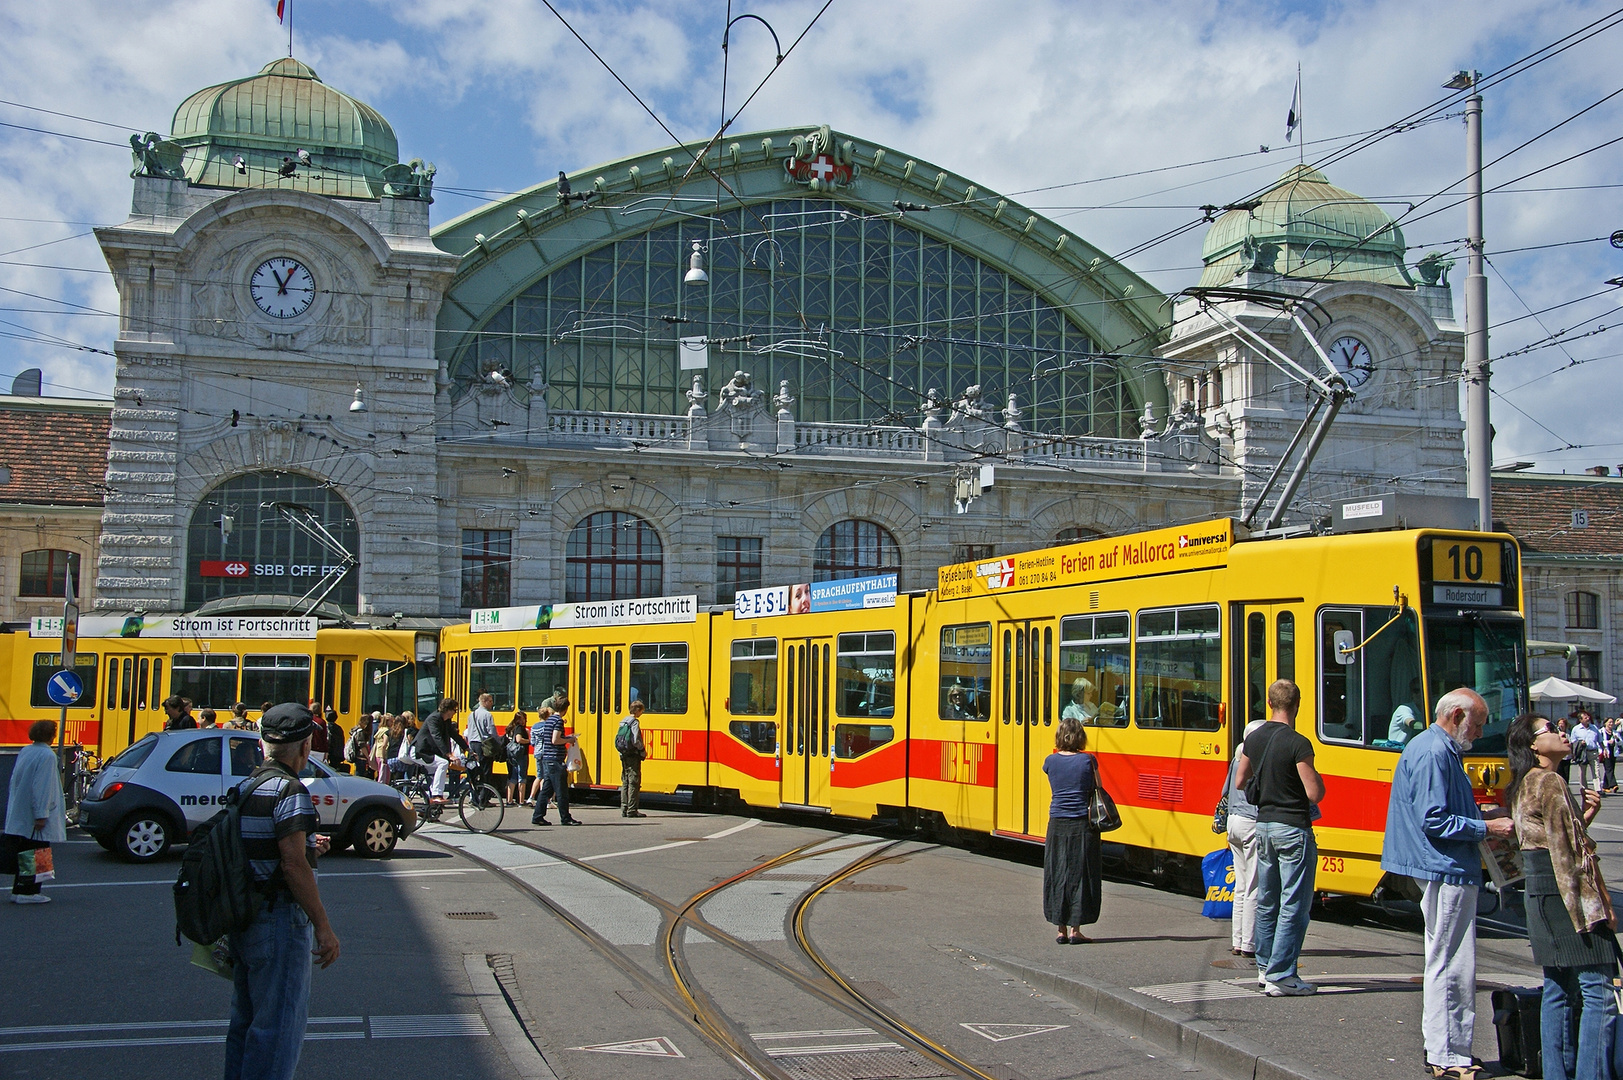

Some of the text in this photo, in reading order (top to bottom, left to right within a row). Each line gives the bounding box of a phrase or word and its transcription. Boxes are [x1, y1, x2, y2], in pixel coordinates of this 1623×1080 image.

[1345, 503, 1380, 512] MUSFELD
[1575, 513, 1585, 524] 15
[1188, 532, 1227, 547] universal
[1061, 541, 1175, 574] Ferien auf Mallorca
[1179, 546, 1227, 558] www.universalmallorca.ch
[1019, 556, 1055, 570] Ferien-Hotline
[1448, 544, 1482, 581] 10
[254, 564, 346, 577] SBB CFF FFS
[941, 567, 973, 583] Reisebüro
[1019, 571, 1057, 585] 061 270 84 84
[812, 576, 896, 600] SPRACHAUFENTHALTE
[961, 583, 973, 594] Basel
[1445, 589, 1487, 602] Rodersdorf
[576, 598, 691, 619] Strom ist Fortschritt
[172, 619, 310, 631] Strom ist Fortschritt
[40, 656, 49, 664] 10
[180, 795, 228, 806] meie
[1322, 856, 1344, 873] 253
[1205, 886, 1235, 902] Tchi
